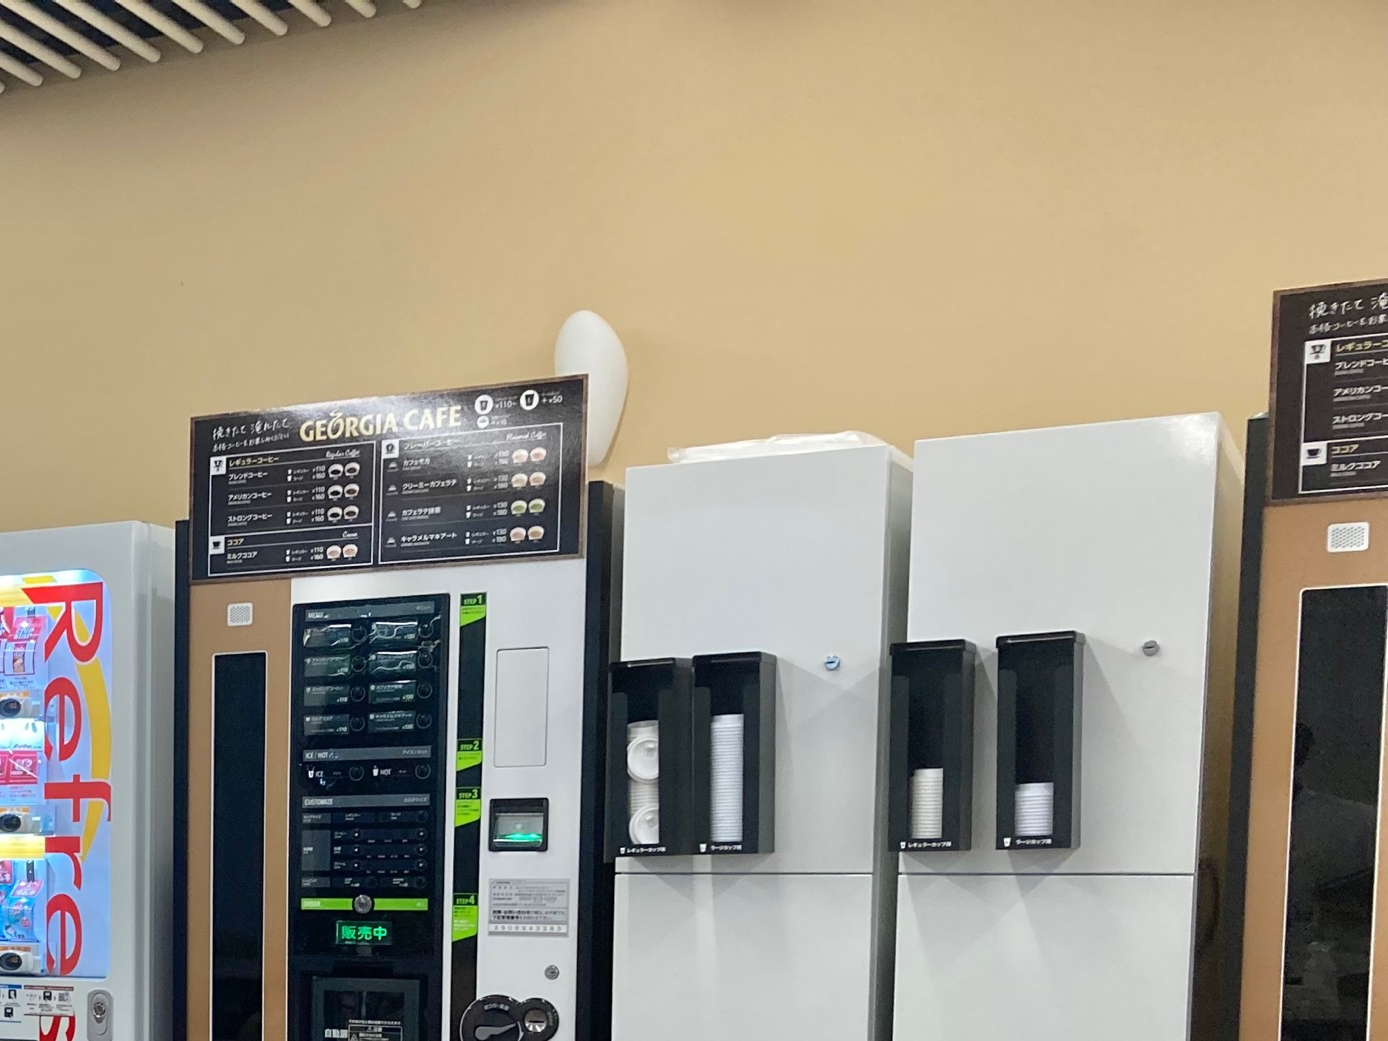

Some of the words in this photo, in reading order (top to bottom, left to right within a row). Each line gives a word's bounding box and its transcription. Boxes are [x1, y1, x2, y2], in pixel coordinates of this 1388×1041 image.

[299, 409, 398, 442] GEORGIA
[404, 405, 462, 431] CAFE
[1331, 444, 1360, 454] ココア
[228, 456, 280, 468] レギュラーコーヒー
[1330, 460, 1381, 471] ミルクココア
[228, 471, 269, 481] ブレンドコーヒー
[402, 478, 458, 491] クリーミーカフェラテ
[227, 491, 272, 501] アメリカンコーヒー
[227, 513, 273, 523] ストロングコーヒー
[227, 538, 245, 546] ココア
[400, 532, 458, 543] キャラメルマキアート
[226, 551, 258, 560] ミルクココア
[341, 925, 387, 941] 販売中
